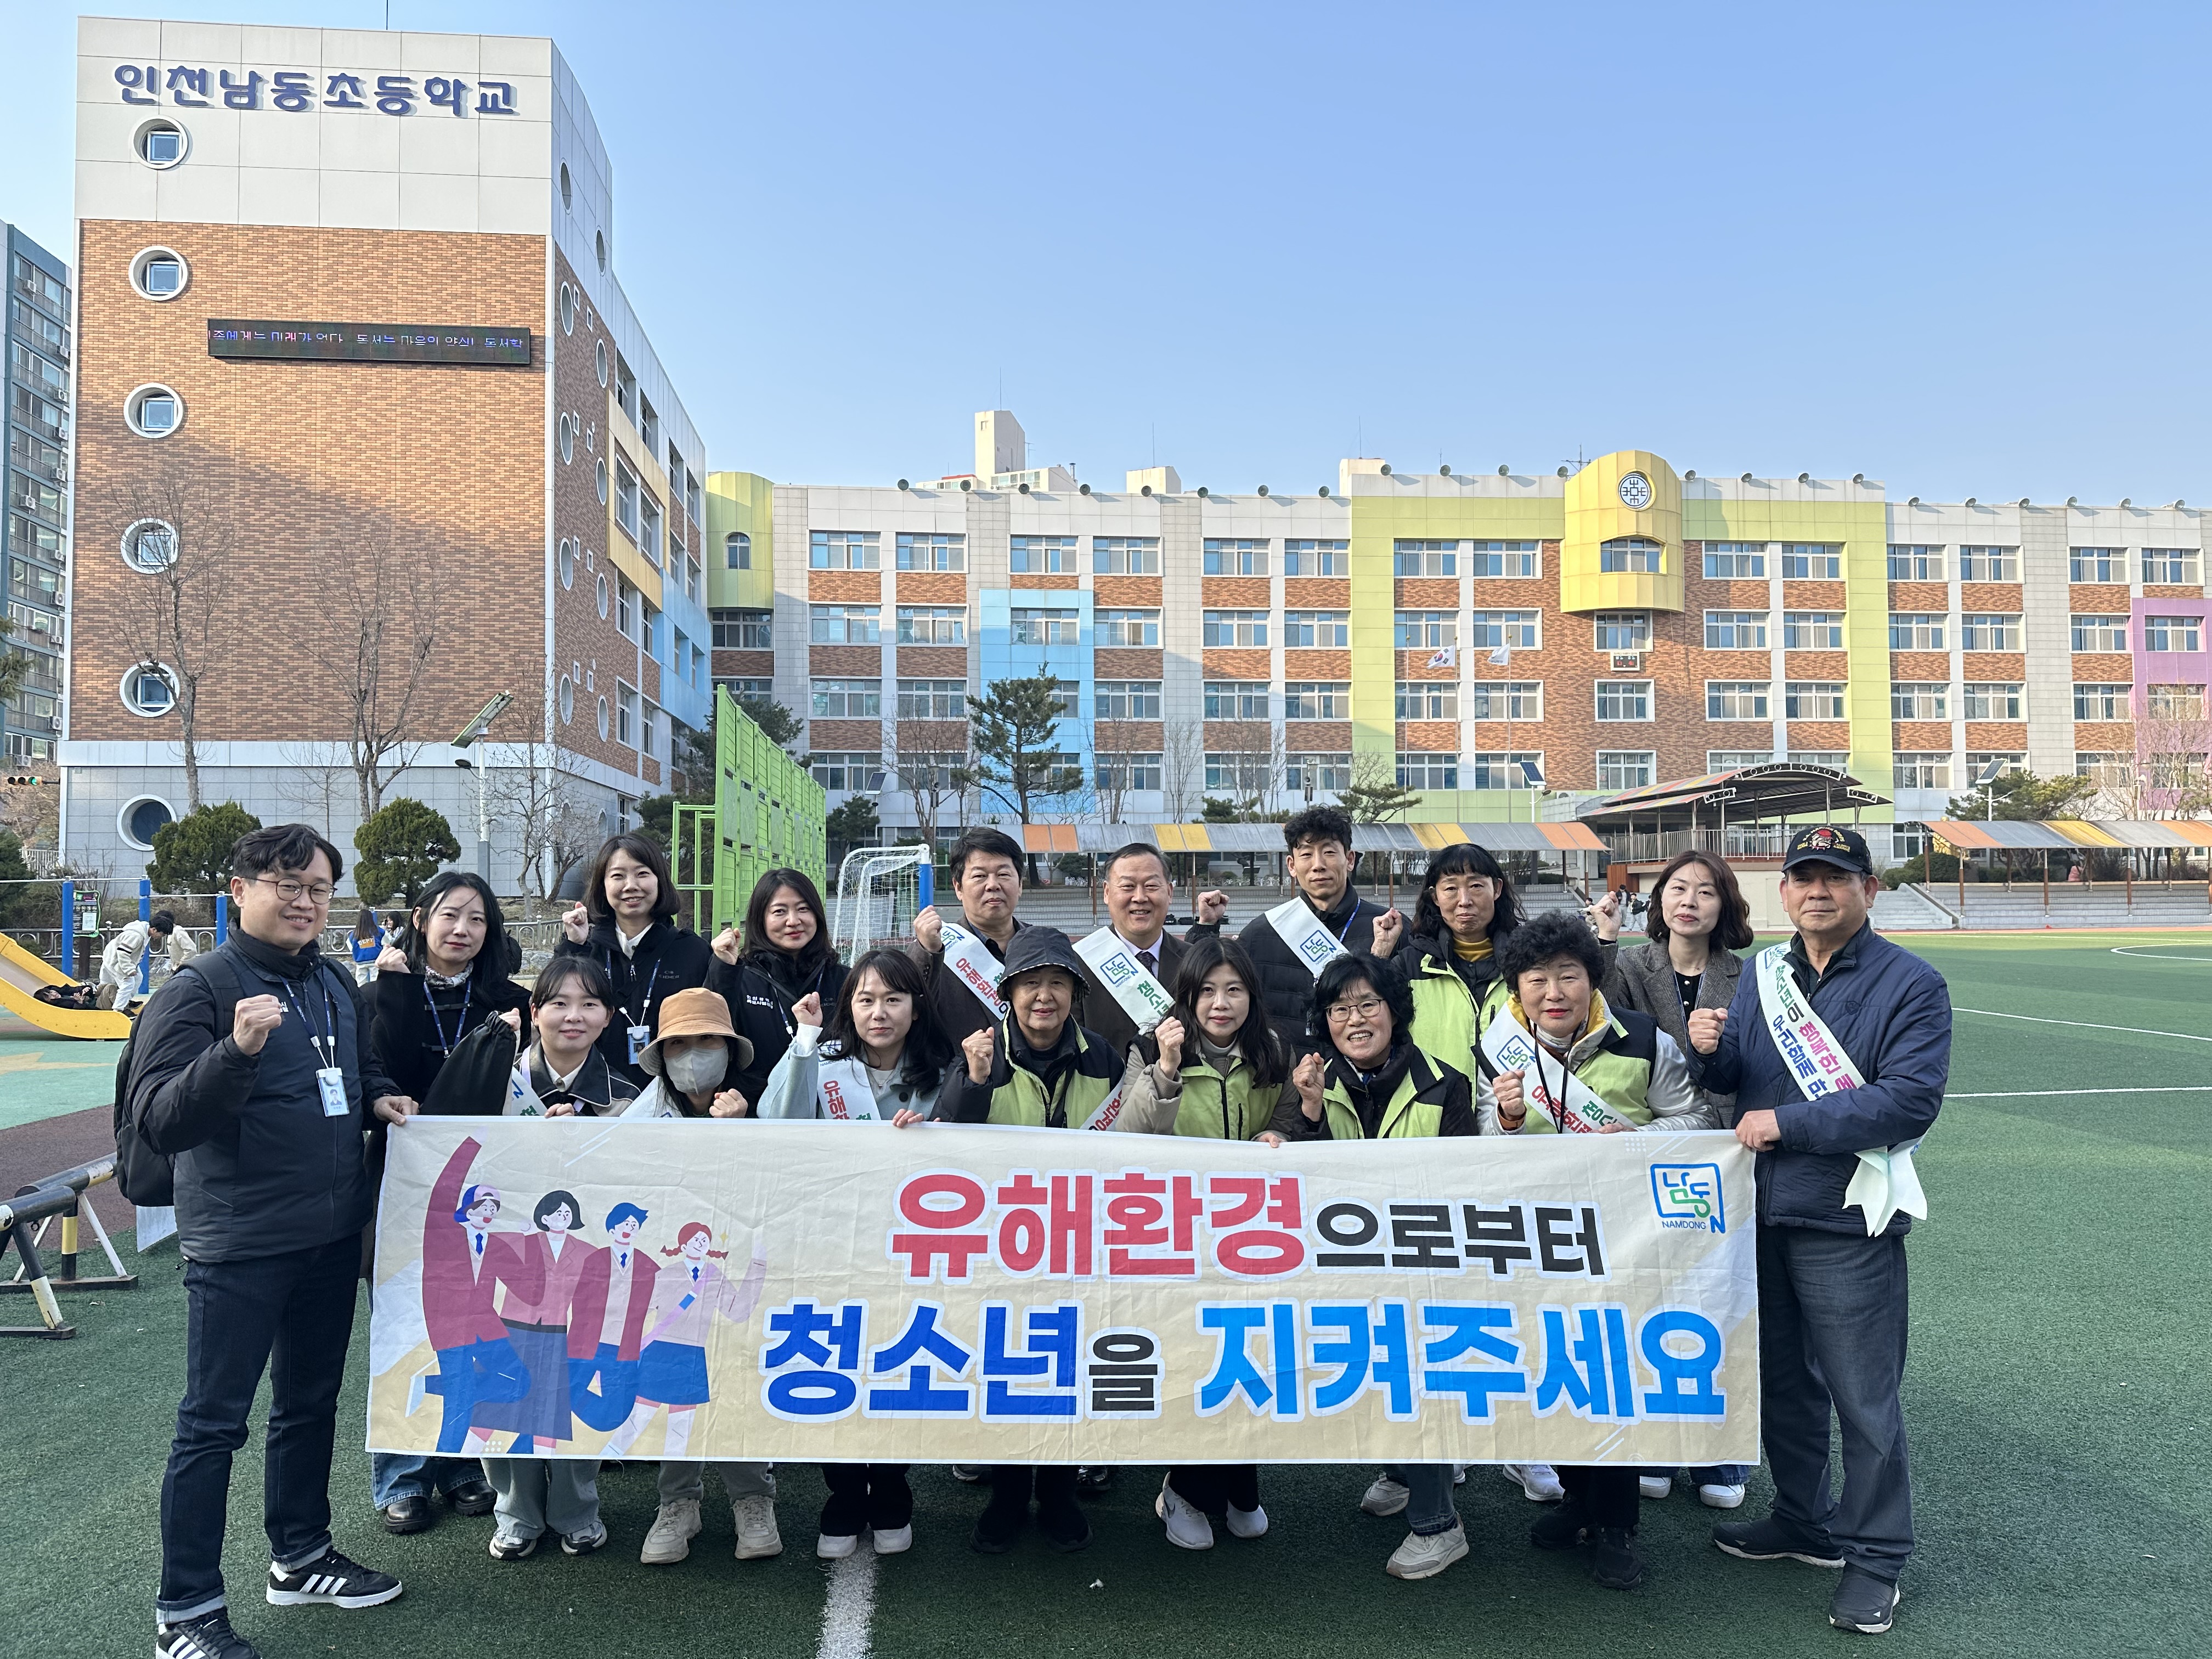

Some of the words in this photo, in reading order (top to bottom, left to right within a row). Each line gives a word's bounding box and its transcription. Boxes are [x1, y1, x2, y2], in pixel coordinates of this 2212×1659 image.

[114, 65, 514, 115] 인천남동초등학교
[1775, 964, 1805, 1023] 청소년이
[1773, 1014, 1818, 1079] 우리함께
[1798, 1021, 1842, 1075] 행복한
[893, 1172, 1604, 1277] 유해환경으로부터
[1661, 1220, 1707, 1229] NAMDONG
[765, 1304, 1158, 1417] 청소년을
[1200, 1304, 1725, 1418] 지켜주세요
